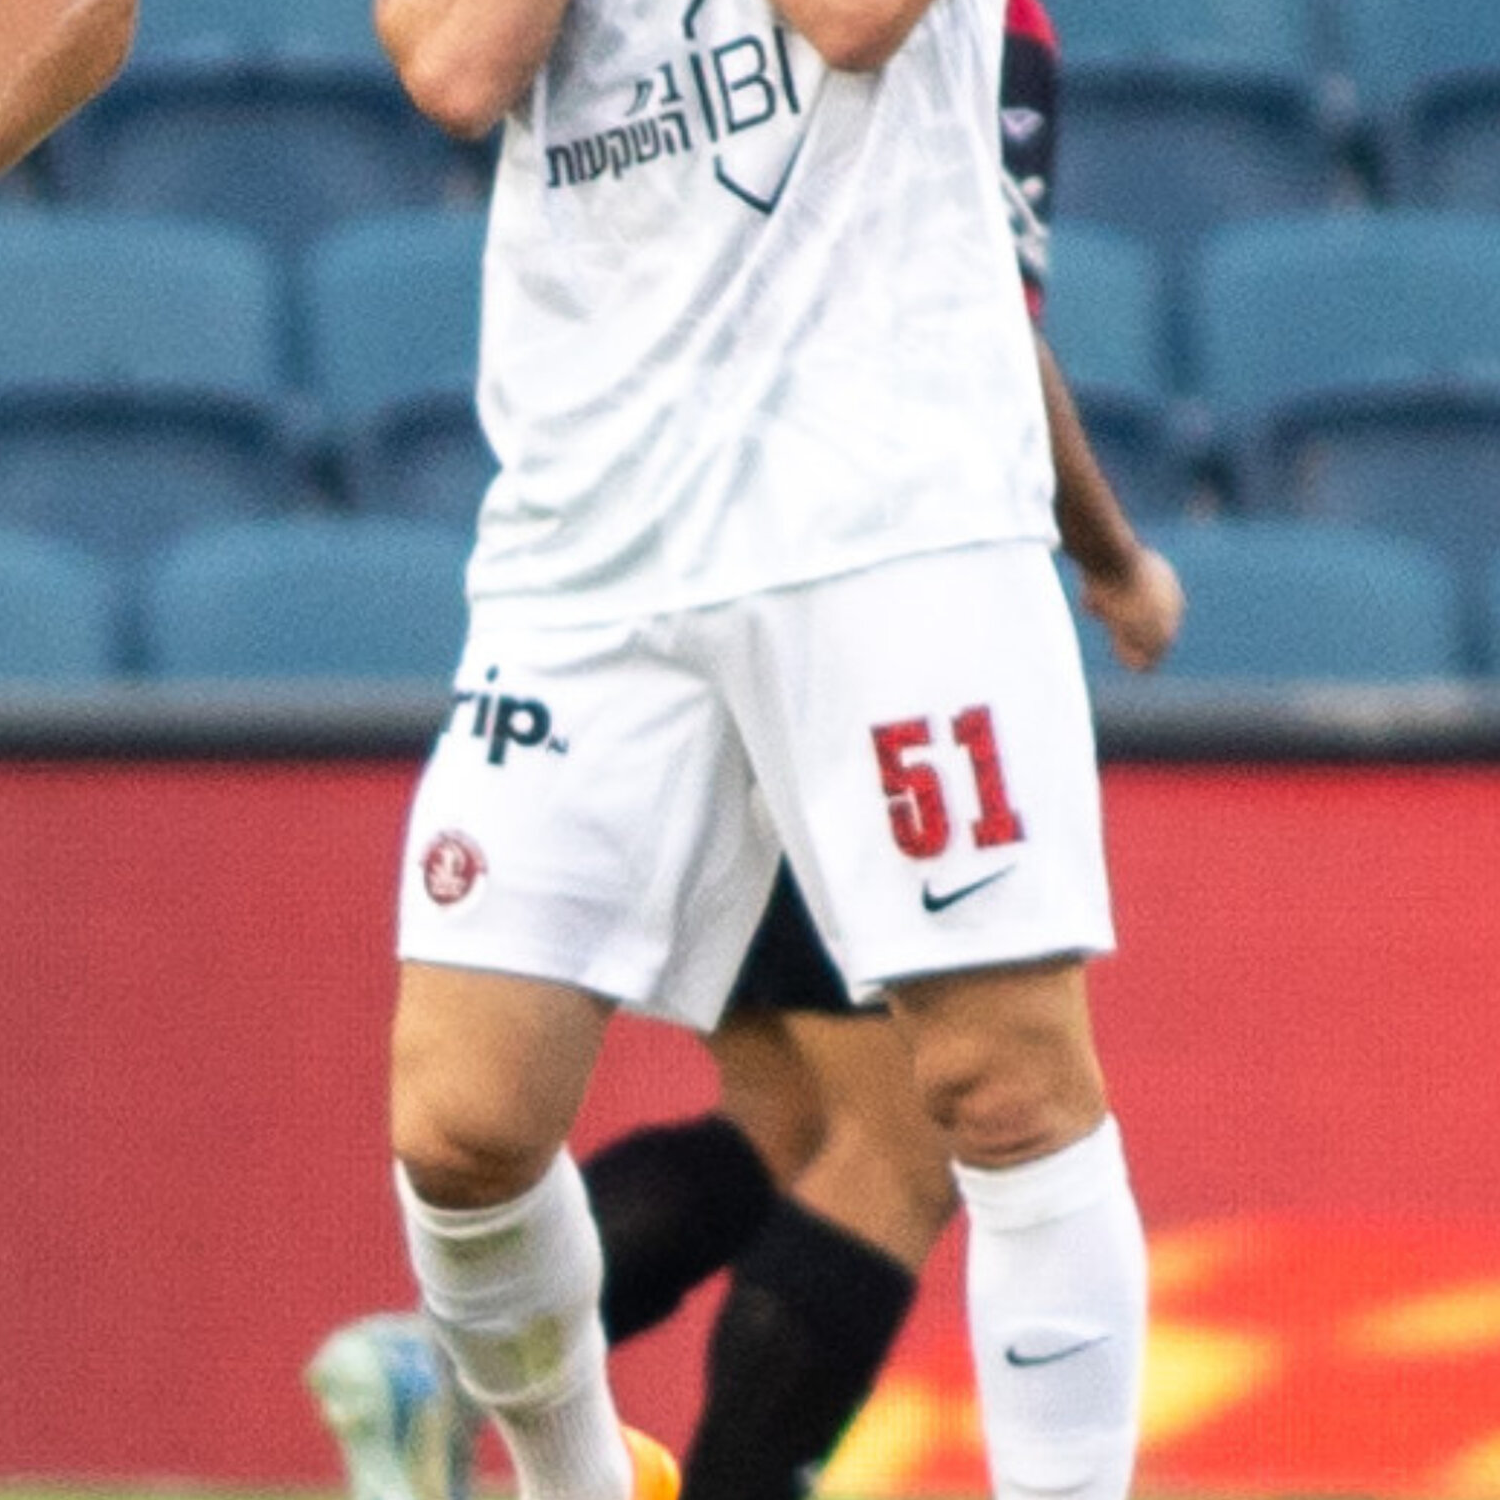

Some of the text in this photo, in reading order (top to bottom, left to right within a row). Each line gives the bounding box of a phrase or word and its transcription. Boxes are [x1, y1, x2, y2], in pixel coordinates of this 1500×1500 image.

[689, 26, 800, 143] IBI
[444, 664, 551, 765] rip
[869, 705, 1026, 859] 51
